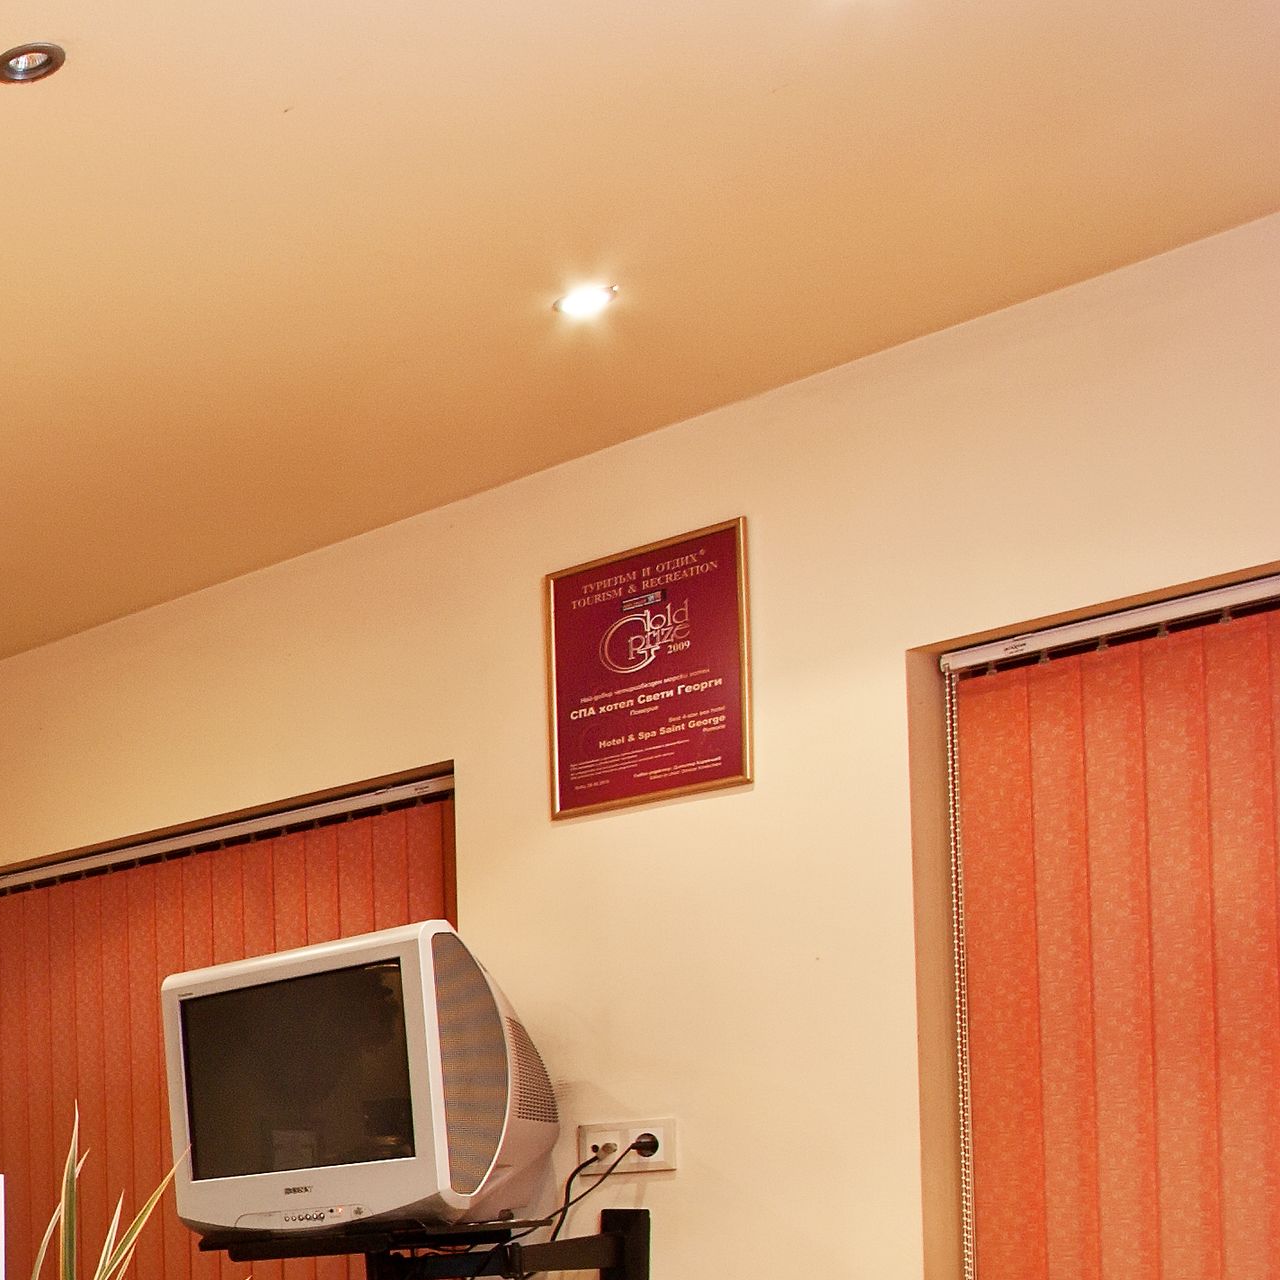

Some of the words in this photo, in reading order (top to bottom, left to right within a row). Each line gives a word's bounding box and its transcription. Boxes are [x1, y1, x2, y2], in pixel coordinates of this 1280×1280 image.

[571, 587, 623, 610] TOURISM
[627, 584, 637, 594] &
[642, 560, 718, 590] RECREATION
[599, 598, 690, 673] Gold
[667, 640, 690, 655] 2009
[570, 708, 596, 720] СПА
[598, 699, 634, 714] хотел
[637, 688, 674, 705] Свети
[677, 677, 723, 696] Георги
[598, 736, 625, 749] Hotel
[627, 734, 635, 742] &
[638, 730, 657, 741] Spa
[659, 723, 685, 735] Saint
[688, 714, 726, 729] George
